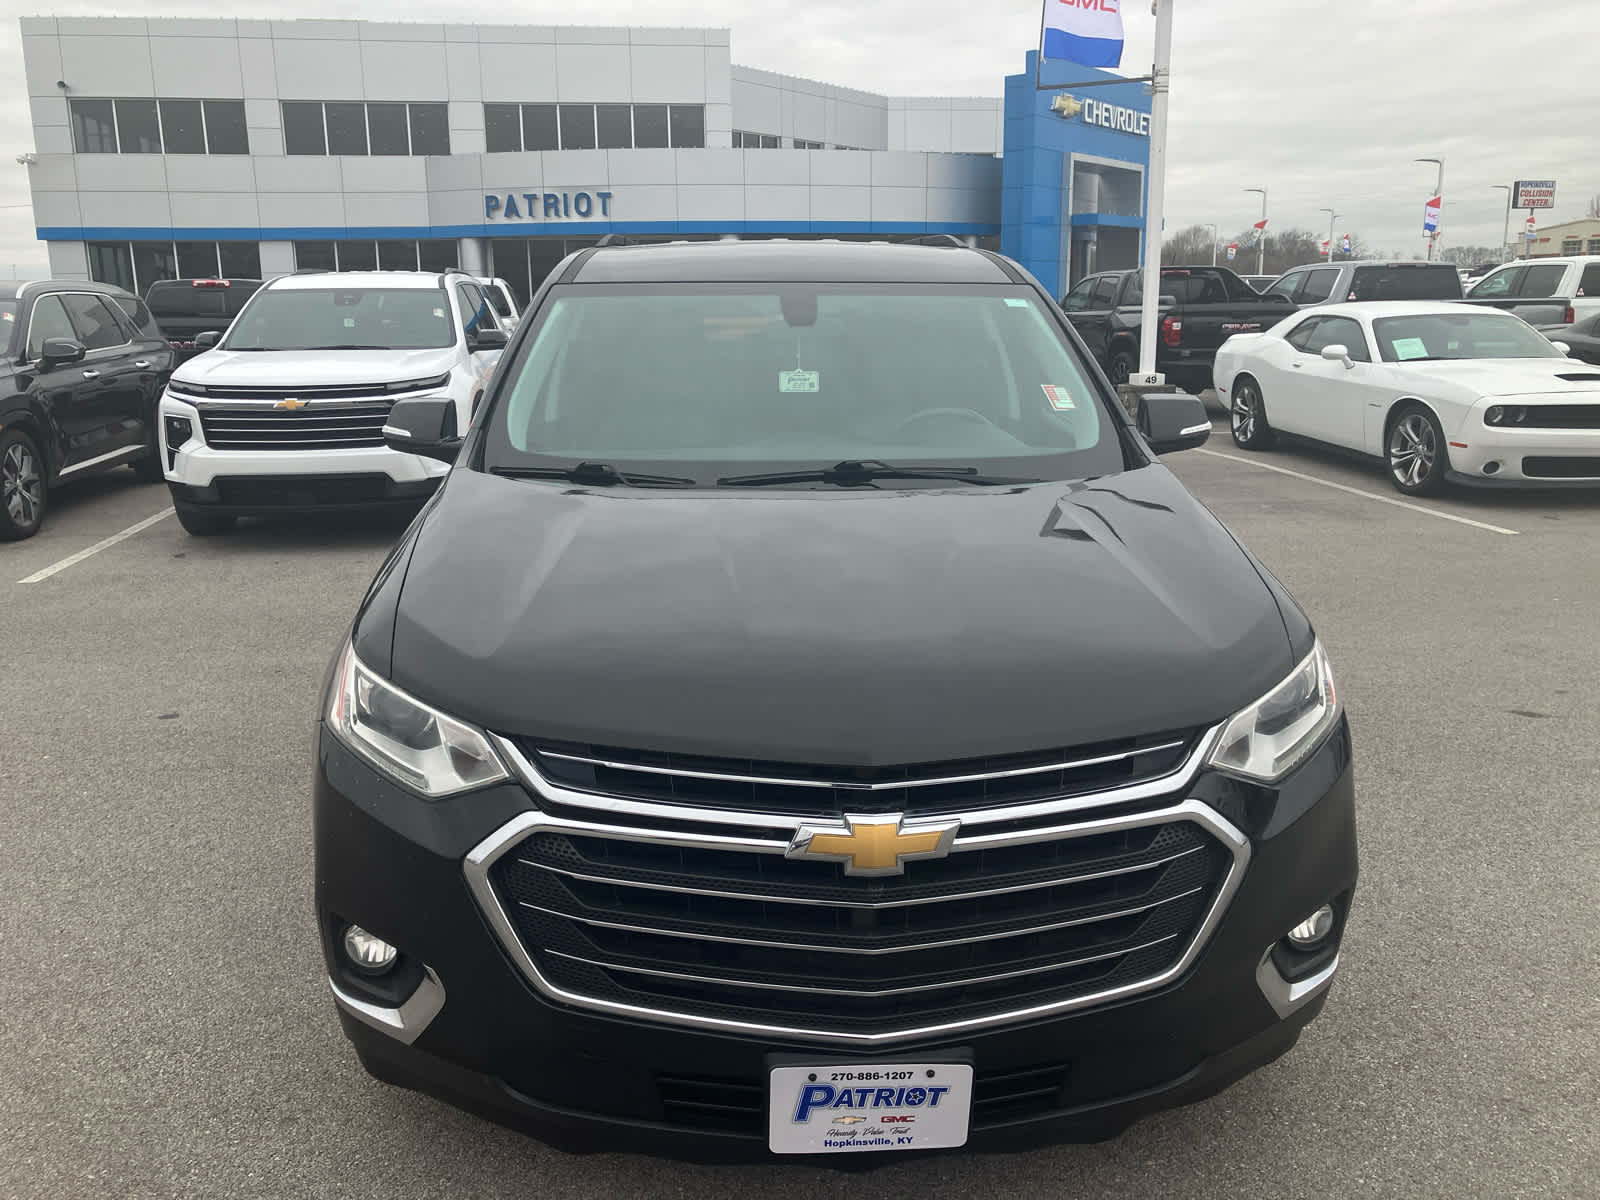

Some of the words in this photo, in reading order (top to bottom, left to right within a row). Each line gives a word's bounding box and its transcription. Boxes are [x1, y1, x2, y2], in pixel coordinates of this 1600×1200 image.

[1520, 189, 1553, 197] COLLISION
[484, 191, 612, 218] PATRIOT
[1523, 198, 1549, 206] CENTER
[1145, 376, 1157, 384] 49
[831, 1071, 914, 1081] 270-886-1207
[792, 1082, 949, 1124] PATRIOT
[880, 1115, 915, 1123] GMC
[824, 1137, 894, 1148] Hopkinsville,
[897, 1136, 913, 1144] KY
